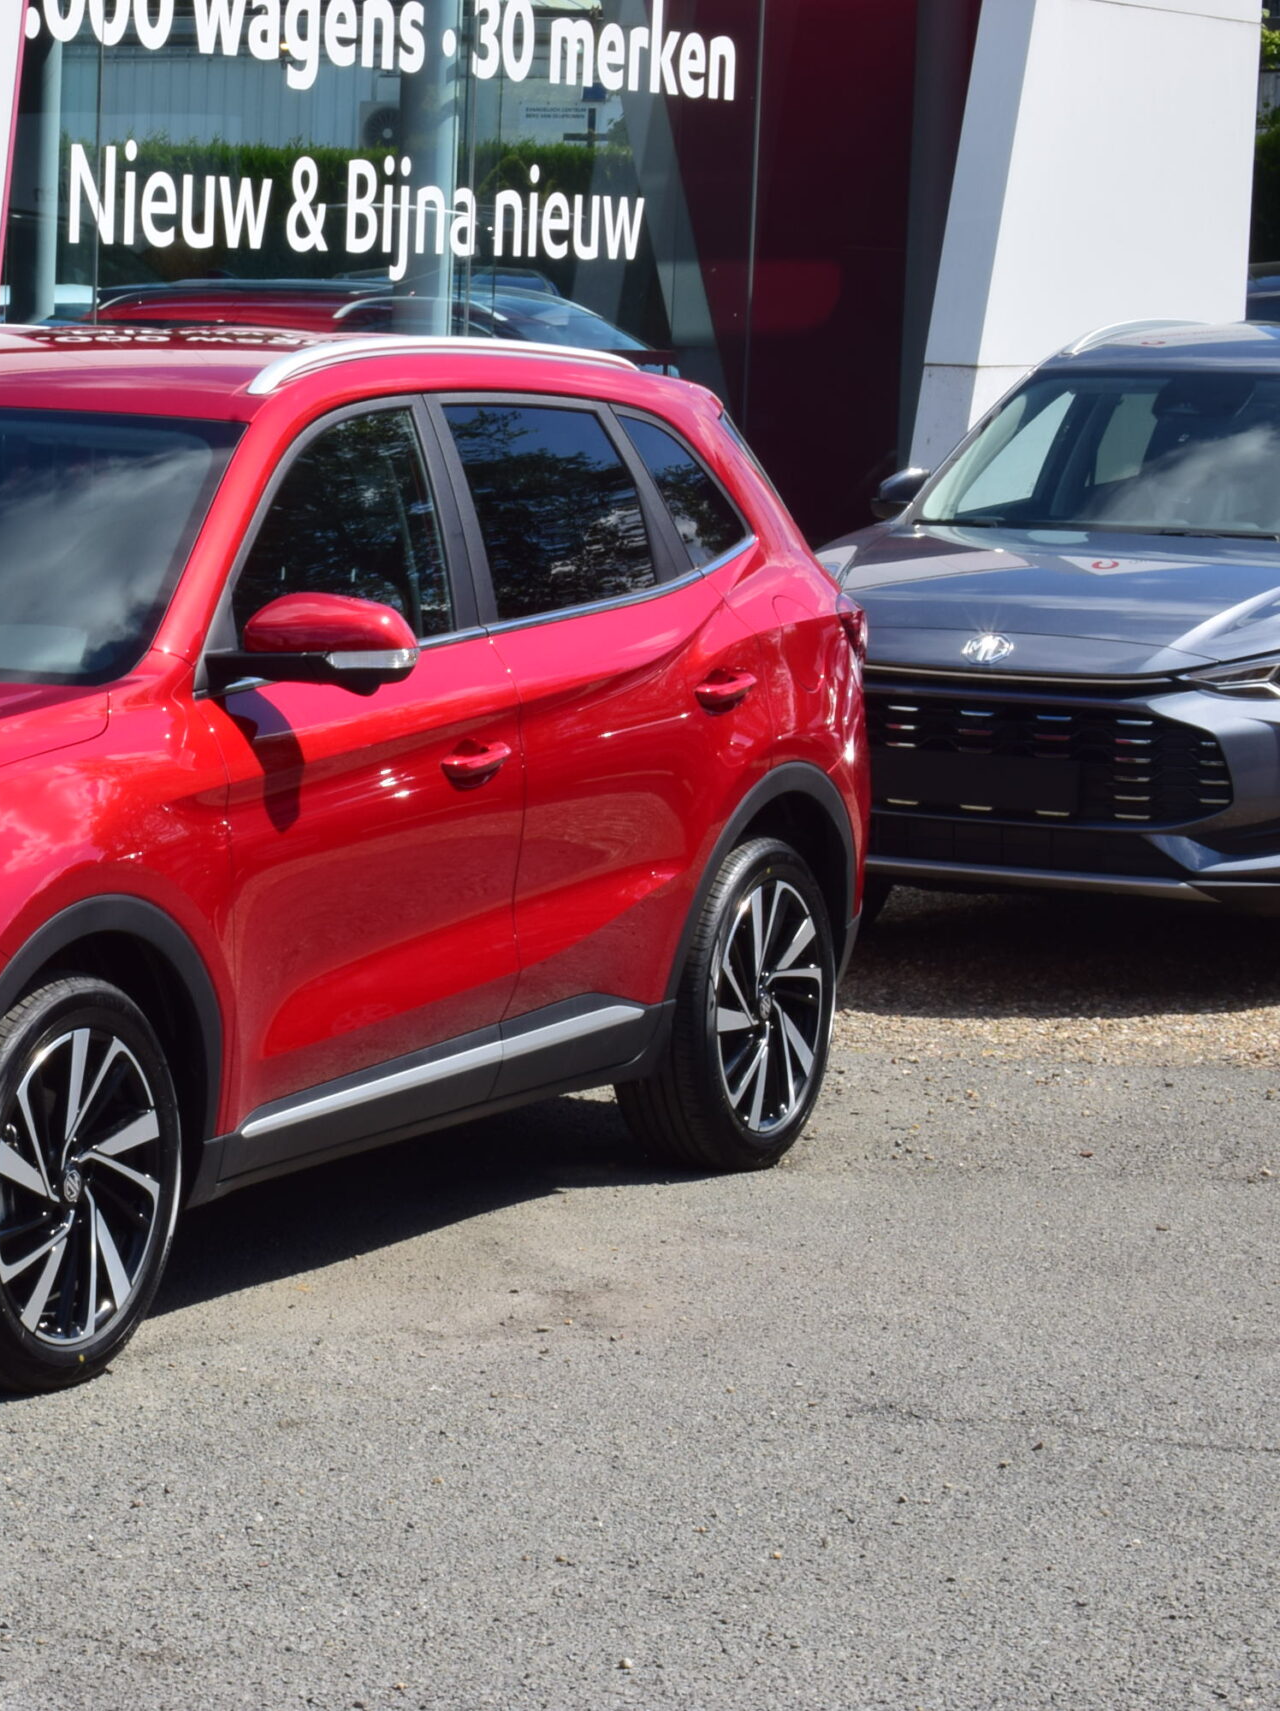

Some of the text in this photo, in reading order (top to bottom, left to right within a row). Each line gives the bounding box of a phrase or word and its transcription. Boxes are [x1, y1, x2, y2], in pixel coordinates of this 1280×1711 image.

[193, 0, 425, 90] wagens
[472, 0, 535, 82] 30
[548, 0, 736, 101] merken
[68, 139, 646, 281] Nieuw & Bijna nieuw
